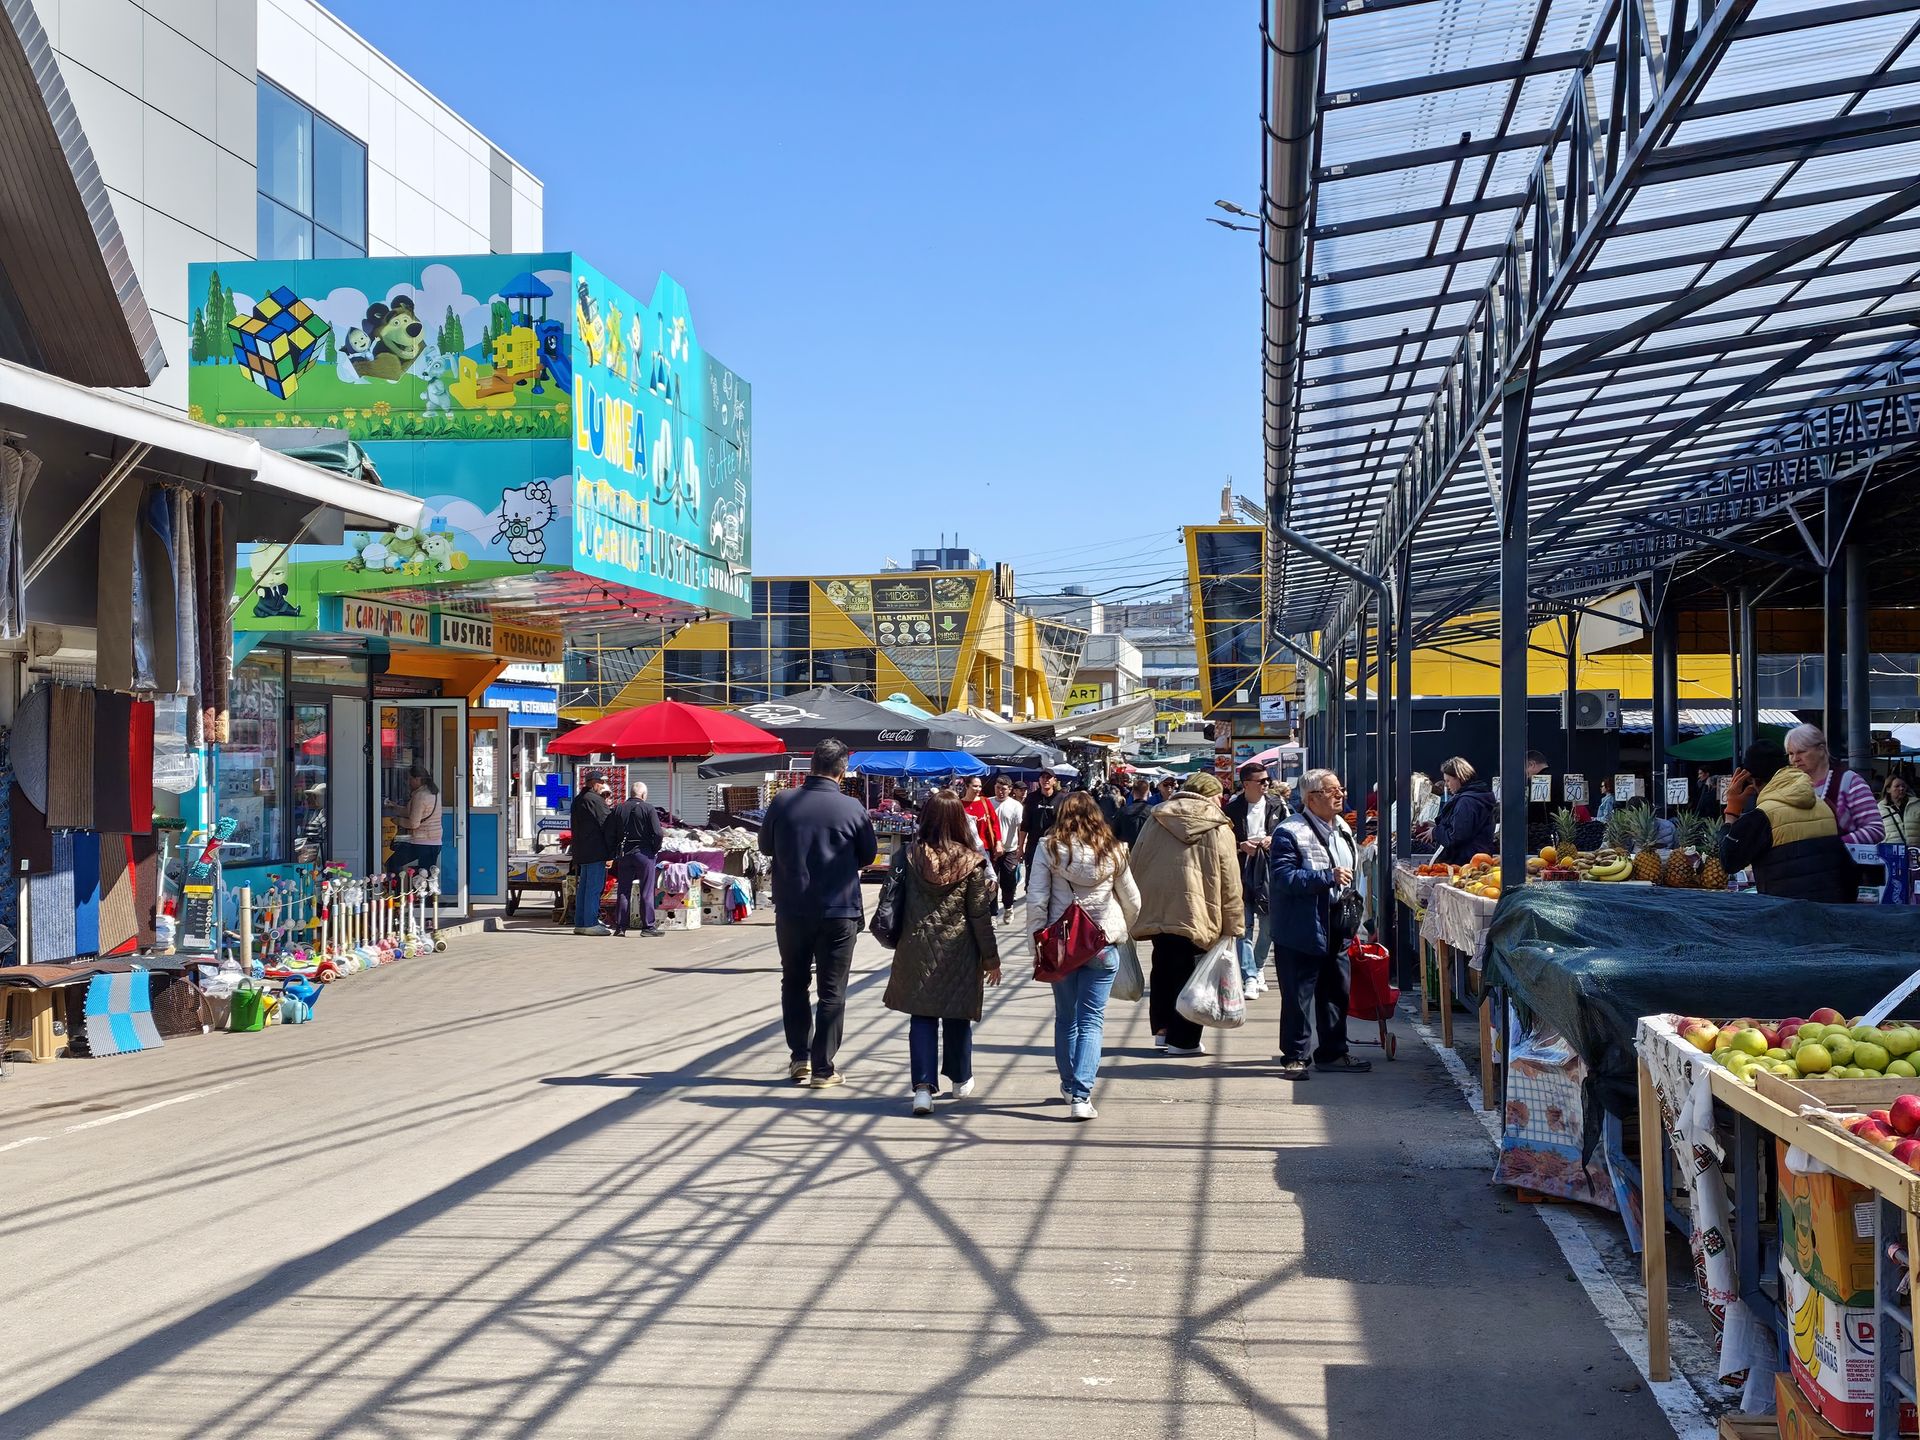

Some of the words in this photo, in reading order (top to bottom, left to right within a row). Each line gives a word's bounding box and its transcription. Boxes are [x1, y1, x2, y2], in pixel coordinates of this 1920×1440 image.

[575, 373, 647, 480] LUMEA
[650, 524, 700, 590] LUSTRE
[708, 564, 744, 599] GURMAND
[877, 614, 892, 622] BAR
[443, 619, 491, 647] LUSTRE
[503, 632, 552, 658] TOBACCO
[1069, 689, 1097, 699] ART
[878, 729, 915, 742] Coca-Cola
[1533, 784, 1549, 801] 100
[1566, 785, 1582, 802] 80
